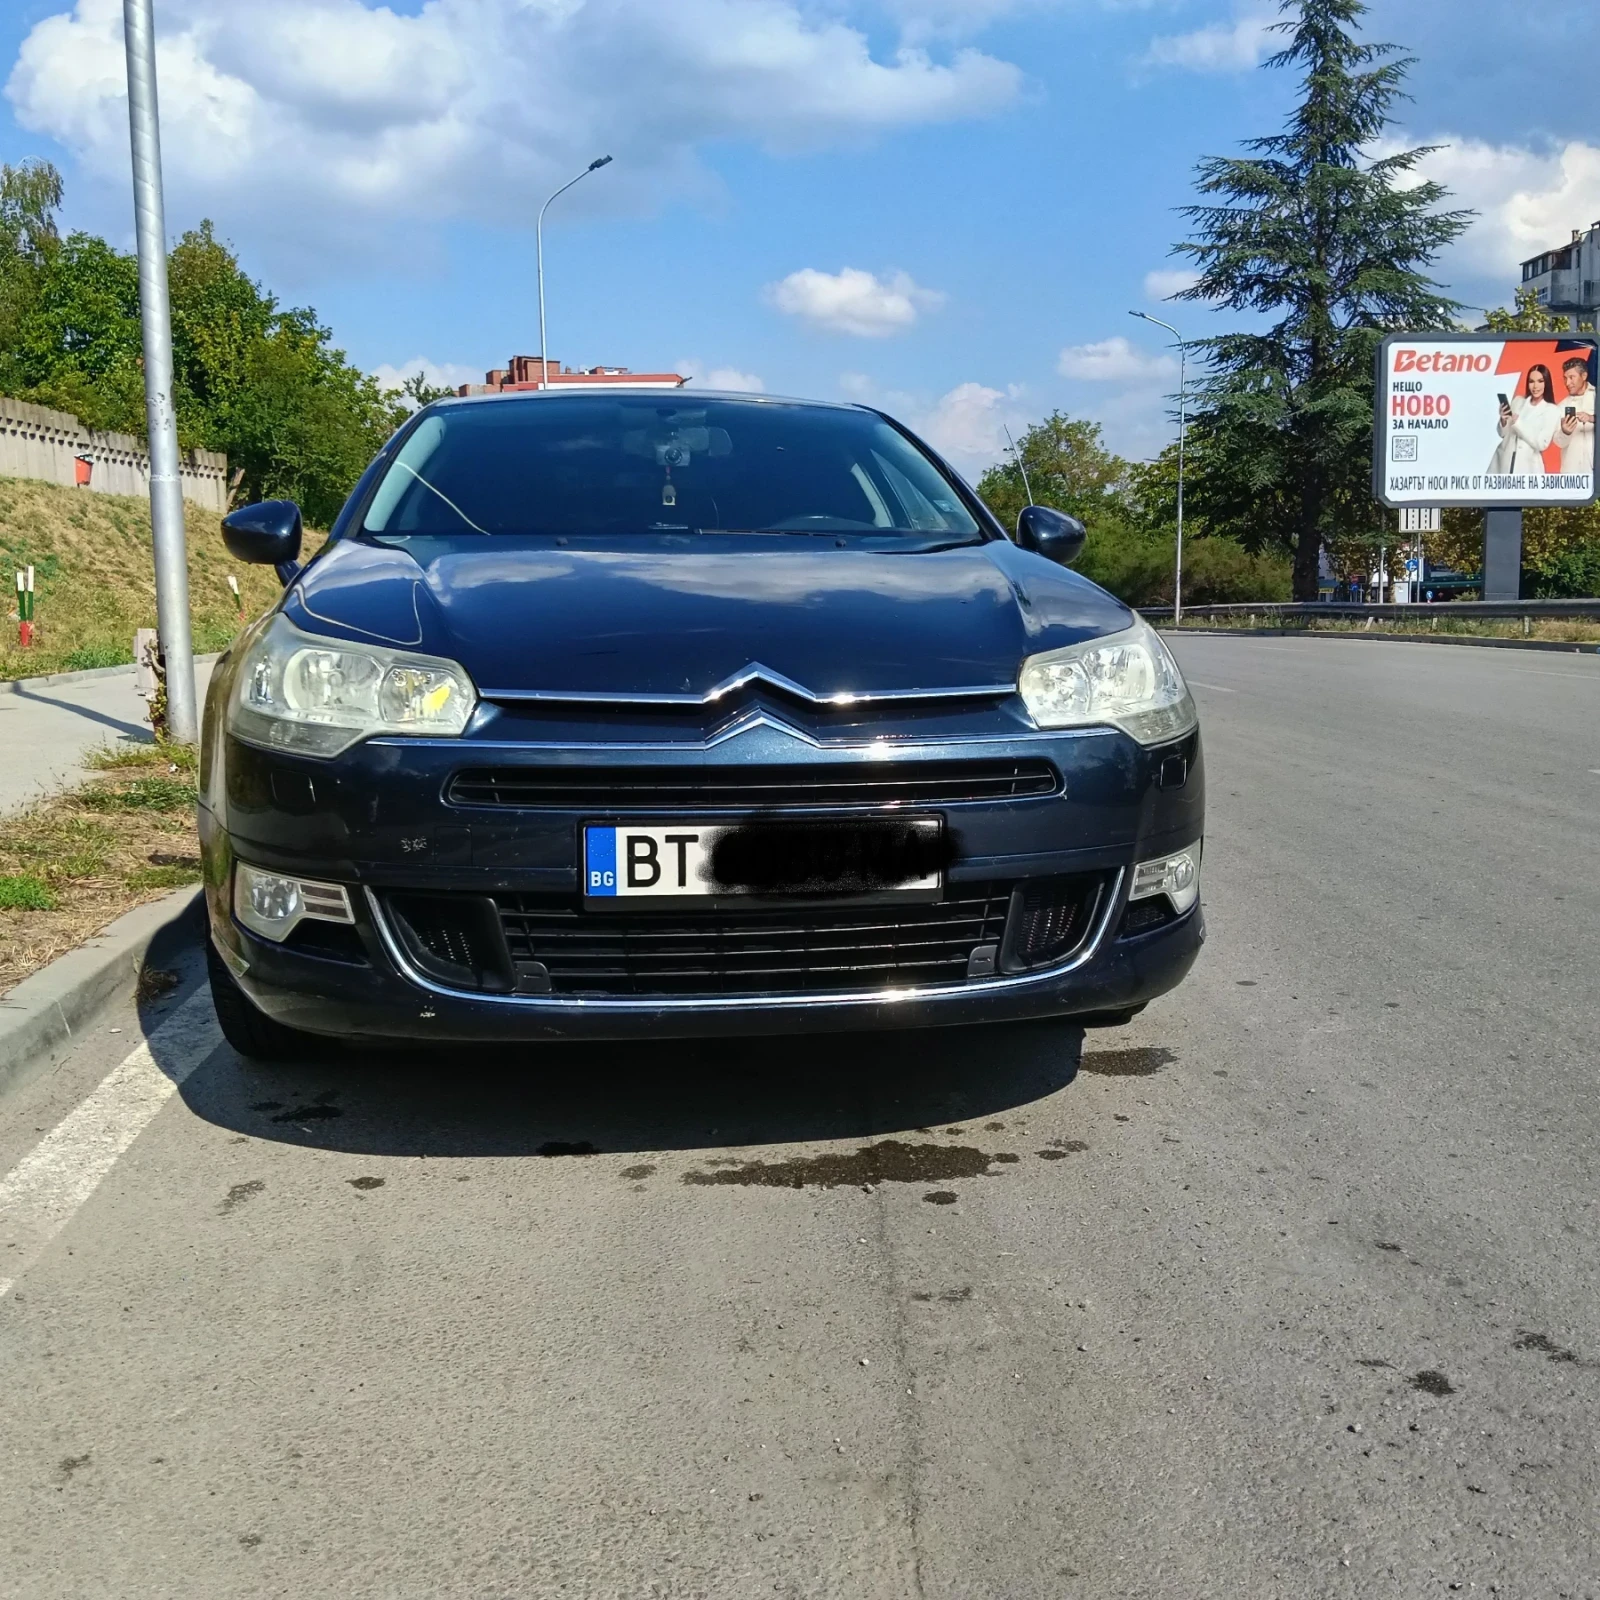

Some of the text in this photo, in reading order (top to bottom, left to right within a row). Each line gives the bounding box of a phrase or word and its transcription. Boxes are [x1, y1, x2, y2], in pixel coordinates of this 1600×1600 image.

[1393, 350, 1492, 372] Betano
[1393, 381, 1423, 393] НЕЩО
[1392, 394, 1451, 416] НОВО
[1392, 419, 1449, 430] ЗА НАЧАЛО
[1390, 475, 1590, 491] ХАЗАРТЪТ НОСИ РИСК ОТ РАЗВИВАНЕ НА ЗАВИСИМОСТ
[590, 871, 614, 887] BG
